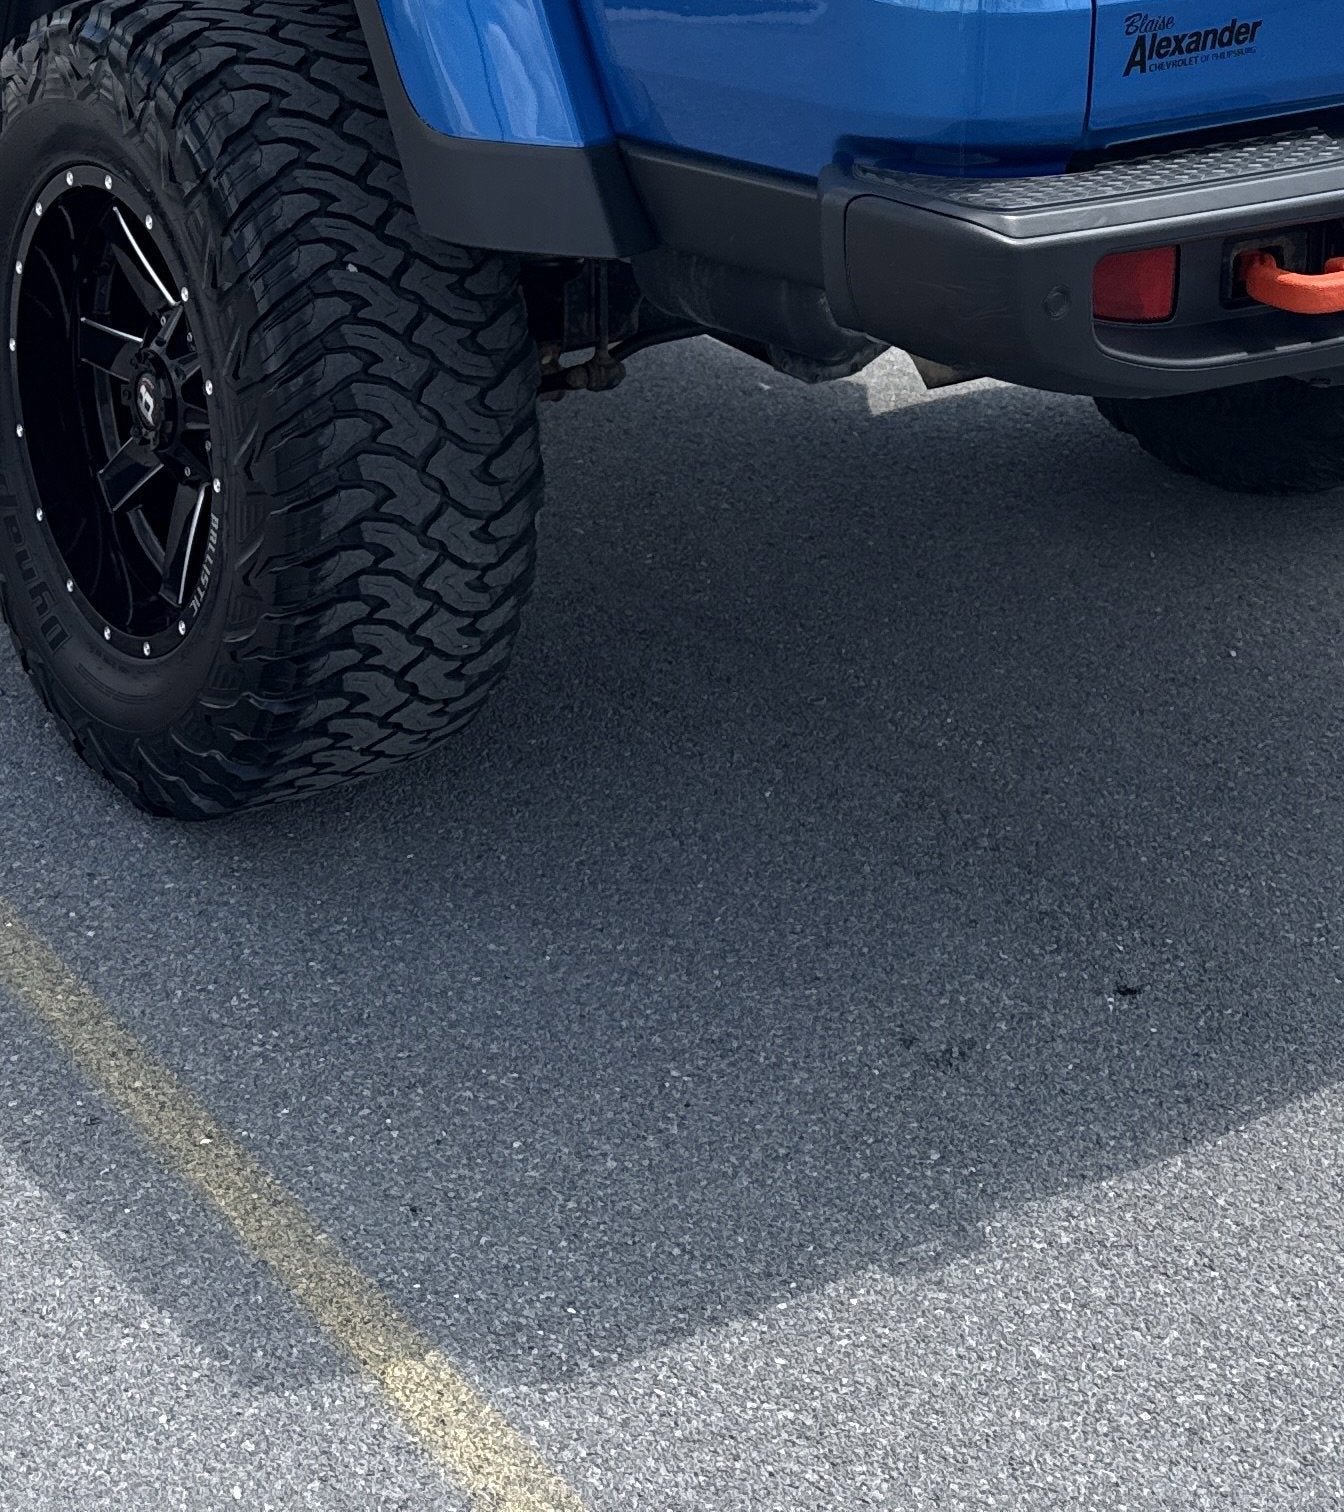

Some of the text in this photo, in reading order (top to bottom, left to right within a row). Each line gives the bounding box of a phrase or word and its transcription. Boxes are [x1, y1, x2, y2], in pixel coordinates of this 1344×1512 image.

[1124, 12, 1175, 36] Blaise
[1122, 19, 1264, 77] Alexander
[1149, 55, 1199, 72] CHEVROLET
[189, 512, 219, 618] BALLISTIC
